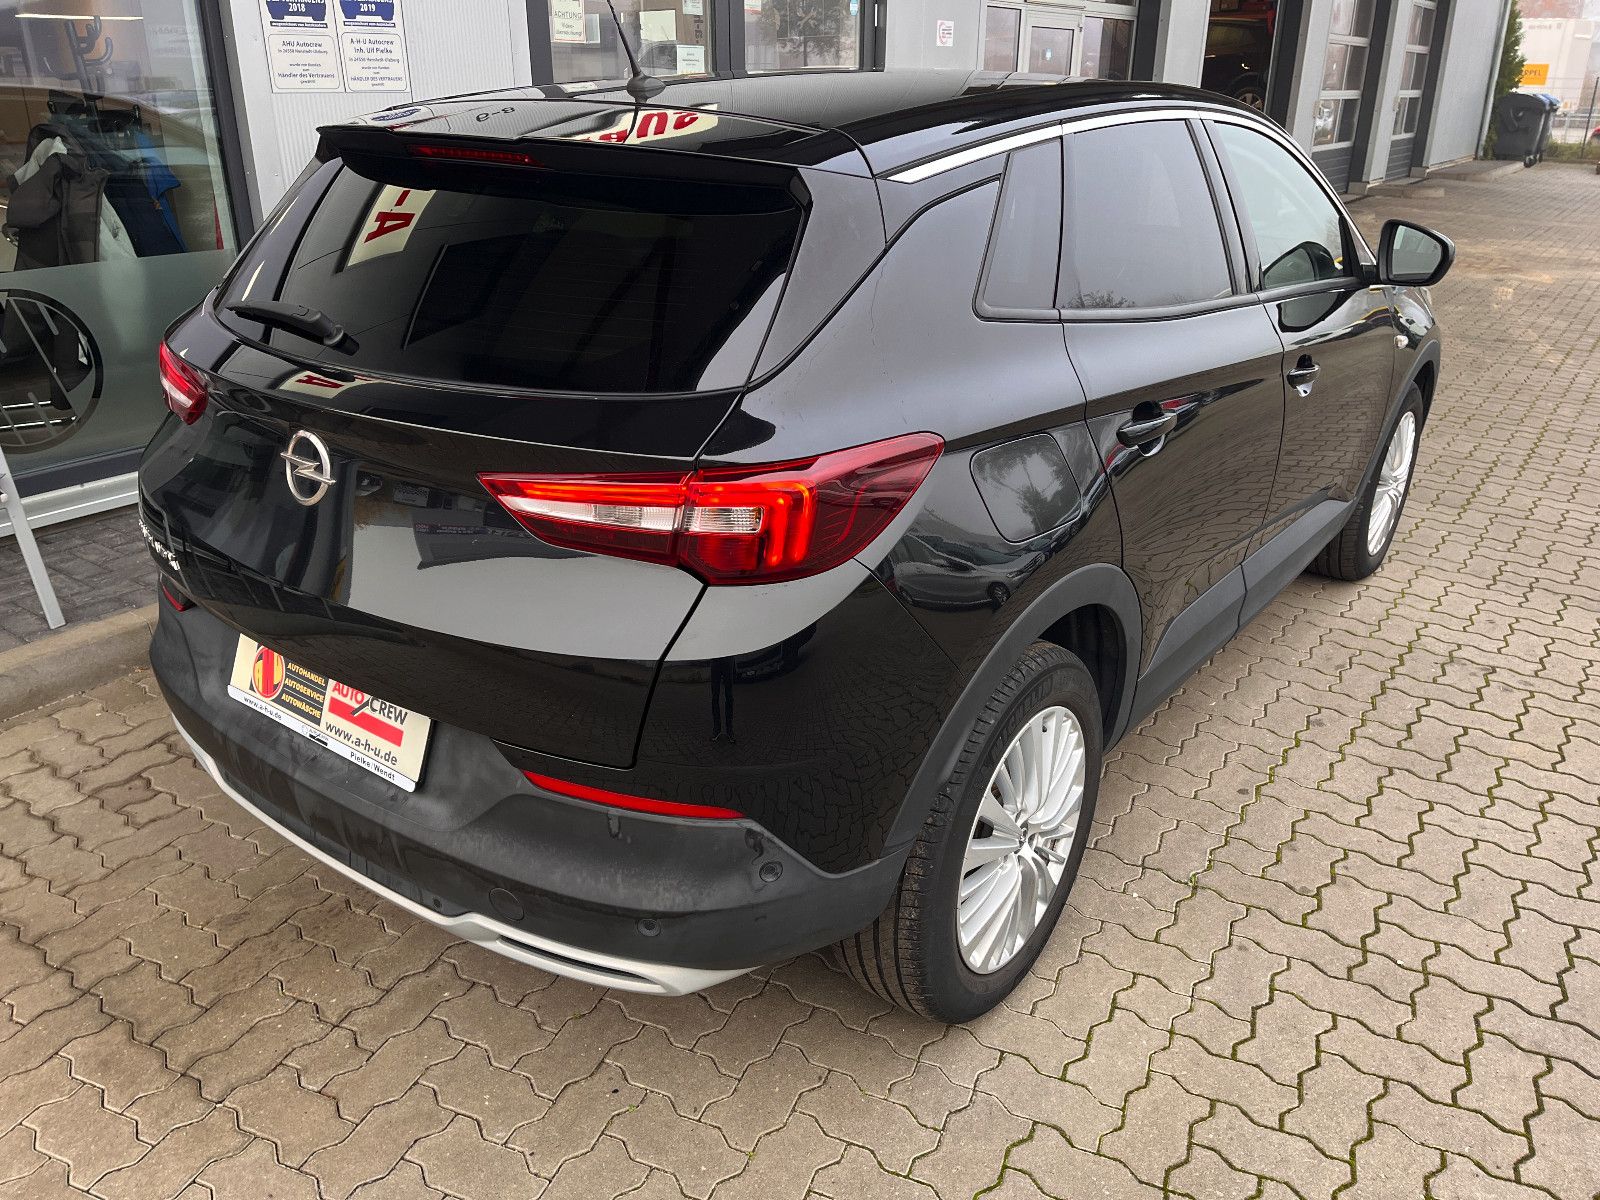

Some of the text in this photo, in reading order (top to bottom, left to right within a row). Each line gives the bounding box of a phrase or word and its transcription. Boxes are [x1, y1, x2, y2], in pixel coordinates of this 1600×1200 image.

[289, 3, 306, 12] 2018
[360, 4, 376, 12] 2019
[287, 662, 326, 687] AUTOHANDEL
[284, 677, 325, 703] AUTOSERVICE
[243, 696, 282, 721] www.a-h-u.de
[281, 692, 322, 719] AUTOWÄSCHE
[332, 681, 408, 726] AUTO CREW
[325, 721, 398, 766] www.a-h-u.de
